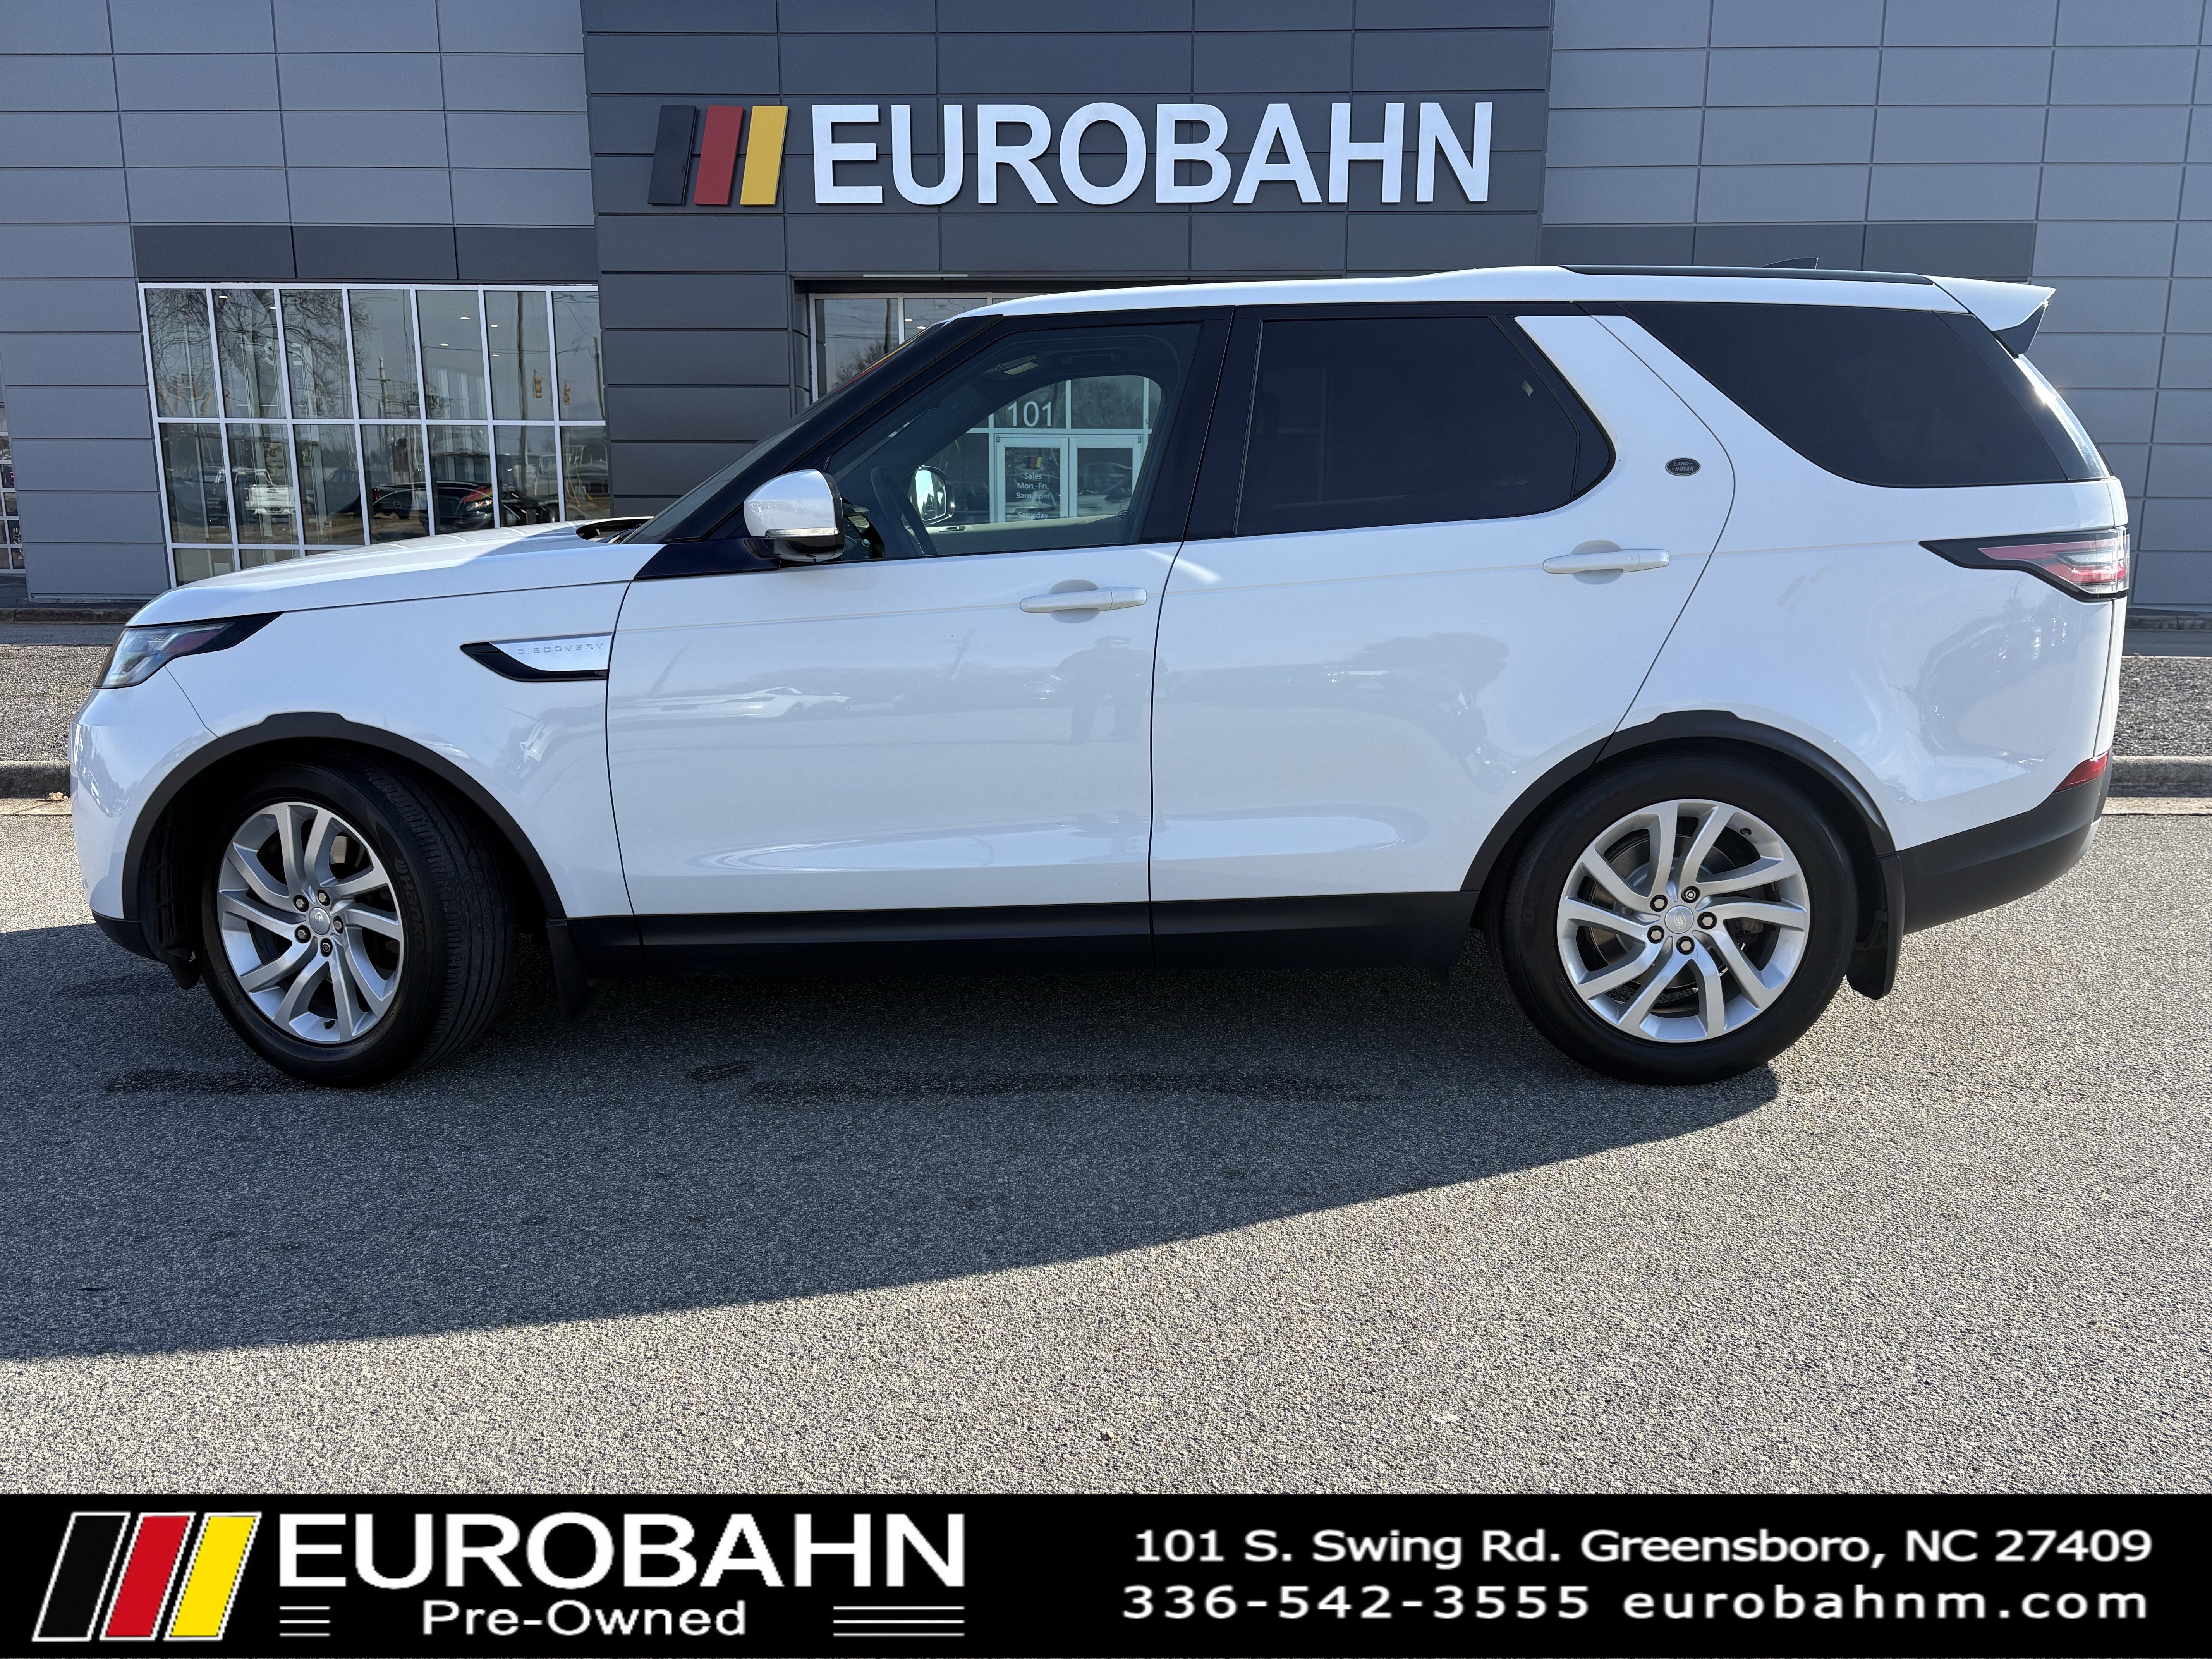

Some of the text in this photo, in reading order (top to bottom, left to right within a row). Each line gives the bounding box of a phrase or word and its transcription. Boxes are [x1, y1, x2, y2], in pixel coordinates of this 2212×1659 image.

[812, 101, 1493, 205] EUROBAHN
[1008, 401, 1051, 427] 101
[517, 642, 604, 654] DISCOVERY
